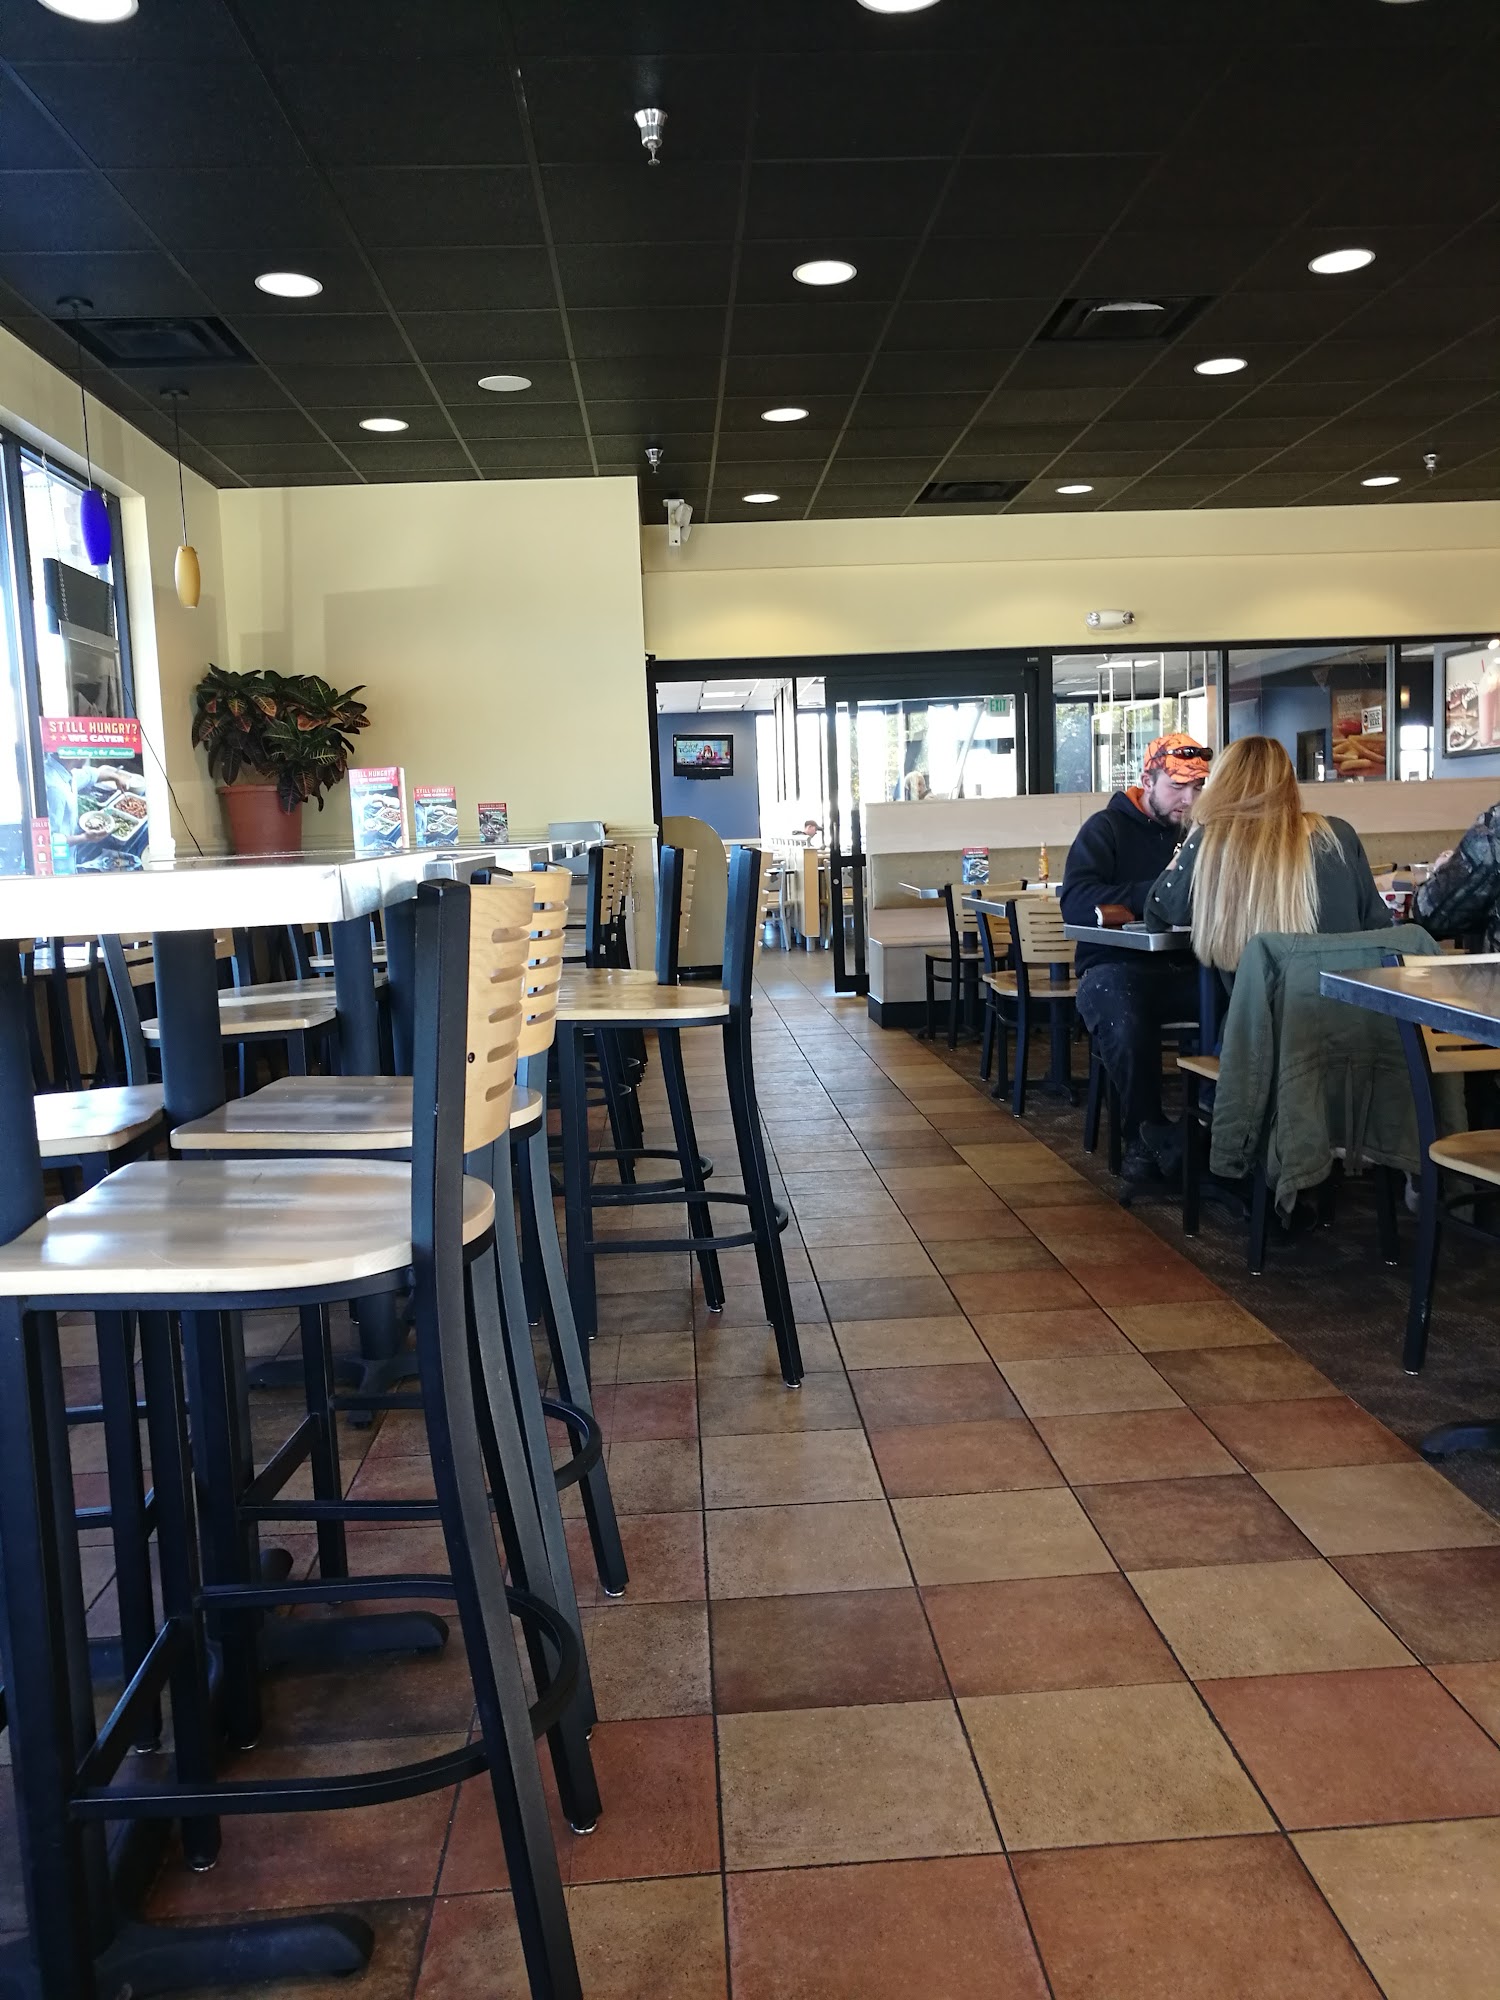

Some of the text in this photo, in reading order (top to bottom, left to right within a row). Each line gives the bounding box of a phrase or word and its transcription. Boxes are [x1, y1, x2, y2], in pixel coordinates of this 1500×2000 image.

[989, 698, 1007, 712] EXIT
[49, 721, 138, 734] STILL HUNGRY?
[67, 734, 124, 743] WE CATER
